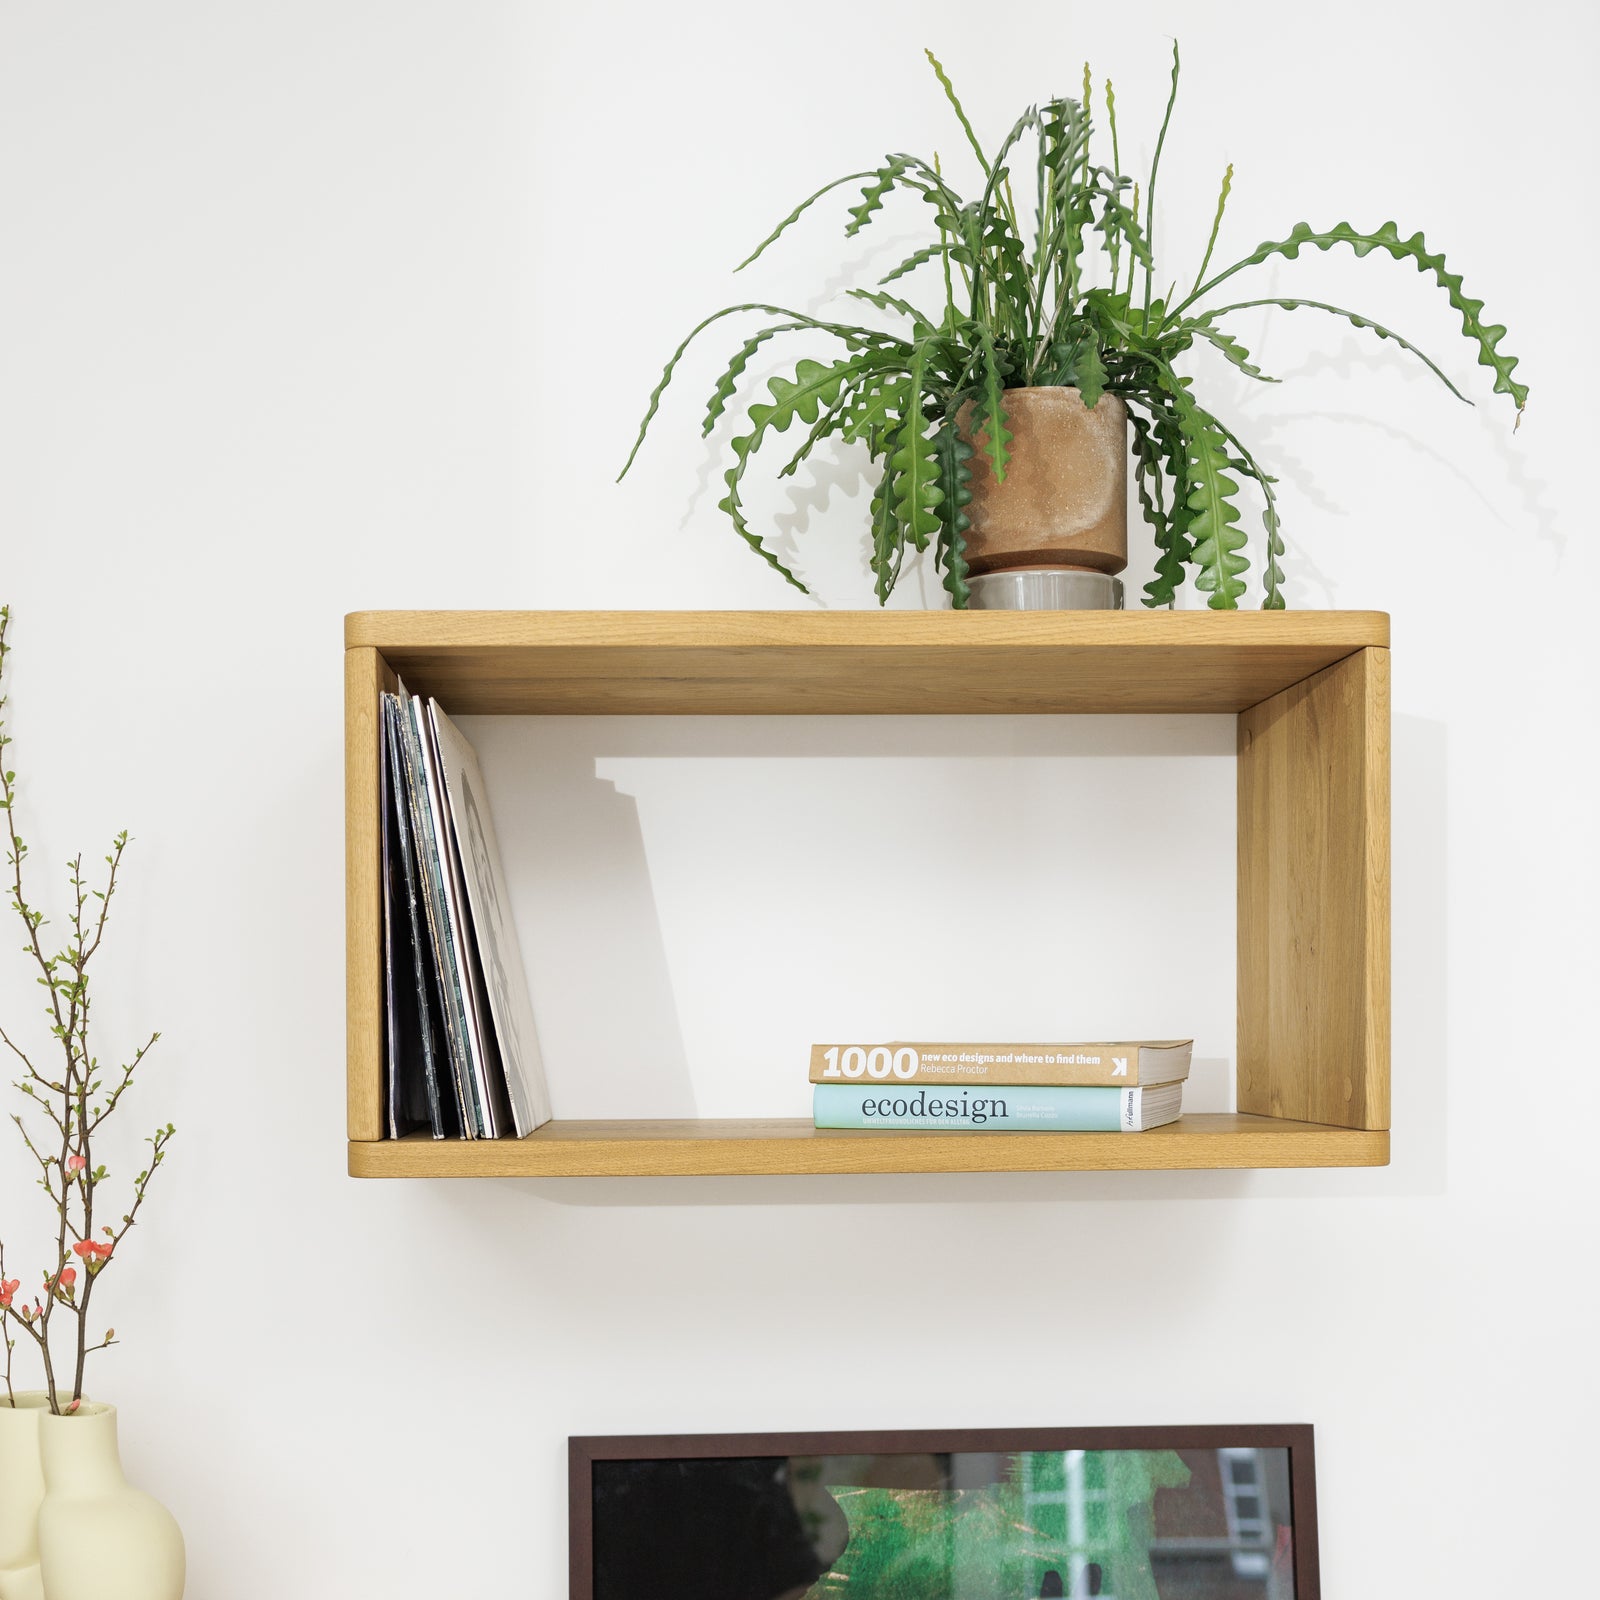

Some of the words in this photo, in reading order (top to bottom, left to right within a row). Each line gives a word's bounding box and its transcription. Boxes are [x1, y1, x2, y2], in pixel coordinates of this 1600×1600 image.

[823, 1046, 918, 1079] 1000
[921, 1054, 941, 1062] new
[942, 1054, 958, 1062] eco
[959, 1052, 994, 1065] designs
[995, 1052, 1013, 1063] and
[1014, 1053, 1043, 1063] where
[1045, 1054, 1055, 1064] to
[1056, 1053, 1074, 1064] find
[1076, 1054, 1100, 1064] them
[921, 1063, 956, 1073] Rebecca
[957, 1064, 988, 1074] Proctor
[861, 1090, 1009, 1124] ecodesign
